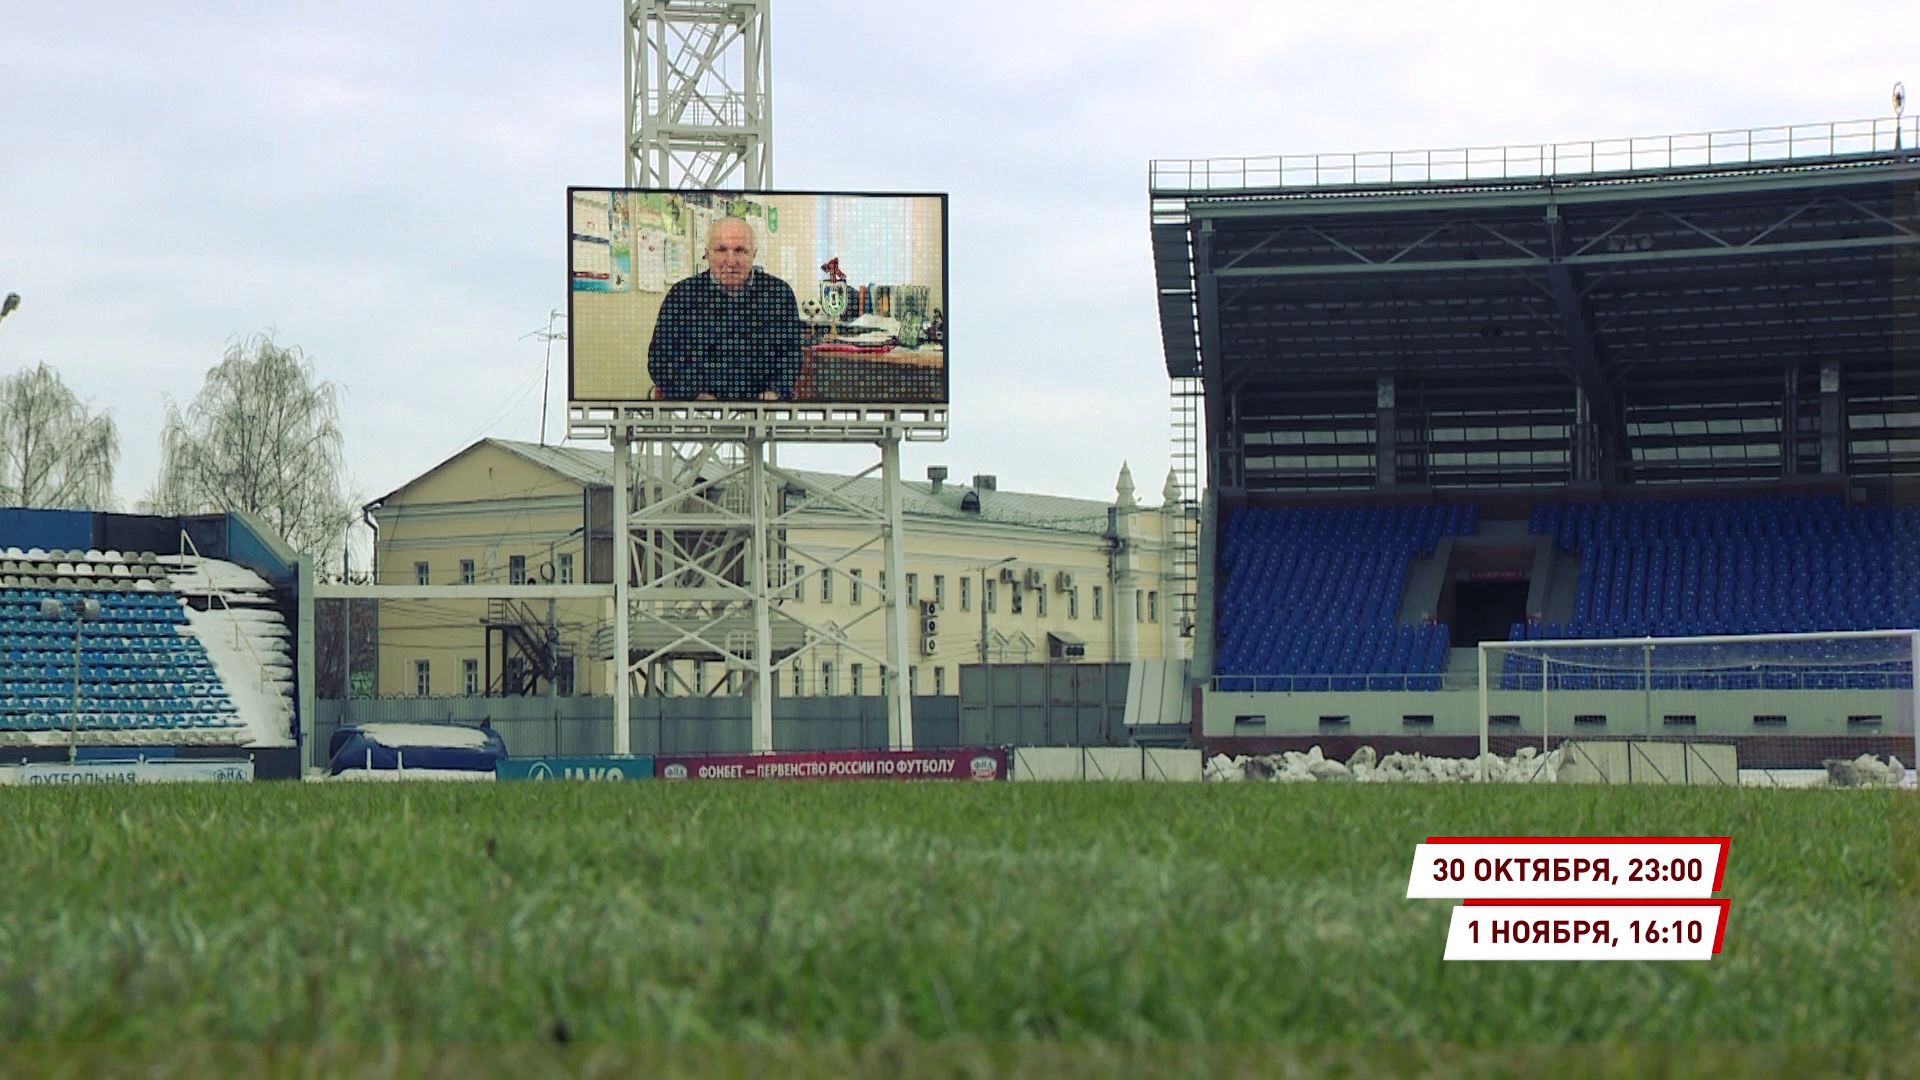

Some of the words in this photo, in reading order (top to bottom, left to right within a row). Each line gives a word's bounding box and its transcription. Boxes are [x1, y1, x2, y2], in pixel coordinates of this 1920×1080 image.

[699, 765, 743, 779] ФОНБЕТ
[757, 763, 827, 778] ПЕРВЕНСТВО
[829, 760, 874, 775] РОССИИ
[876, 760, 894, 774] ПО
[896, 759, 955, 774] ФУТБОЛУ
